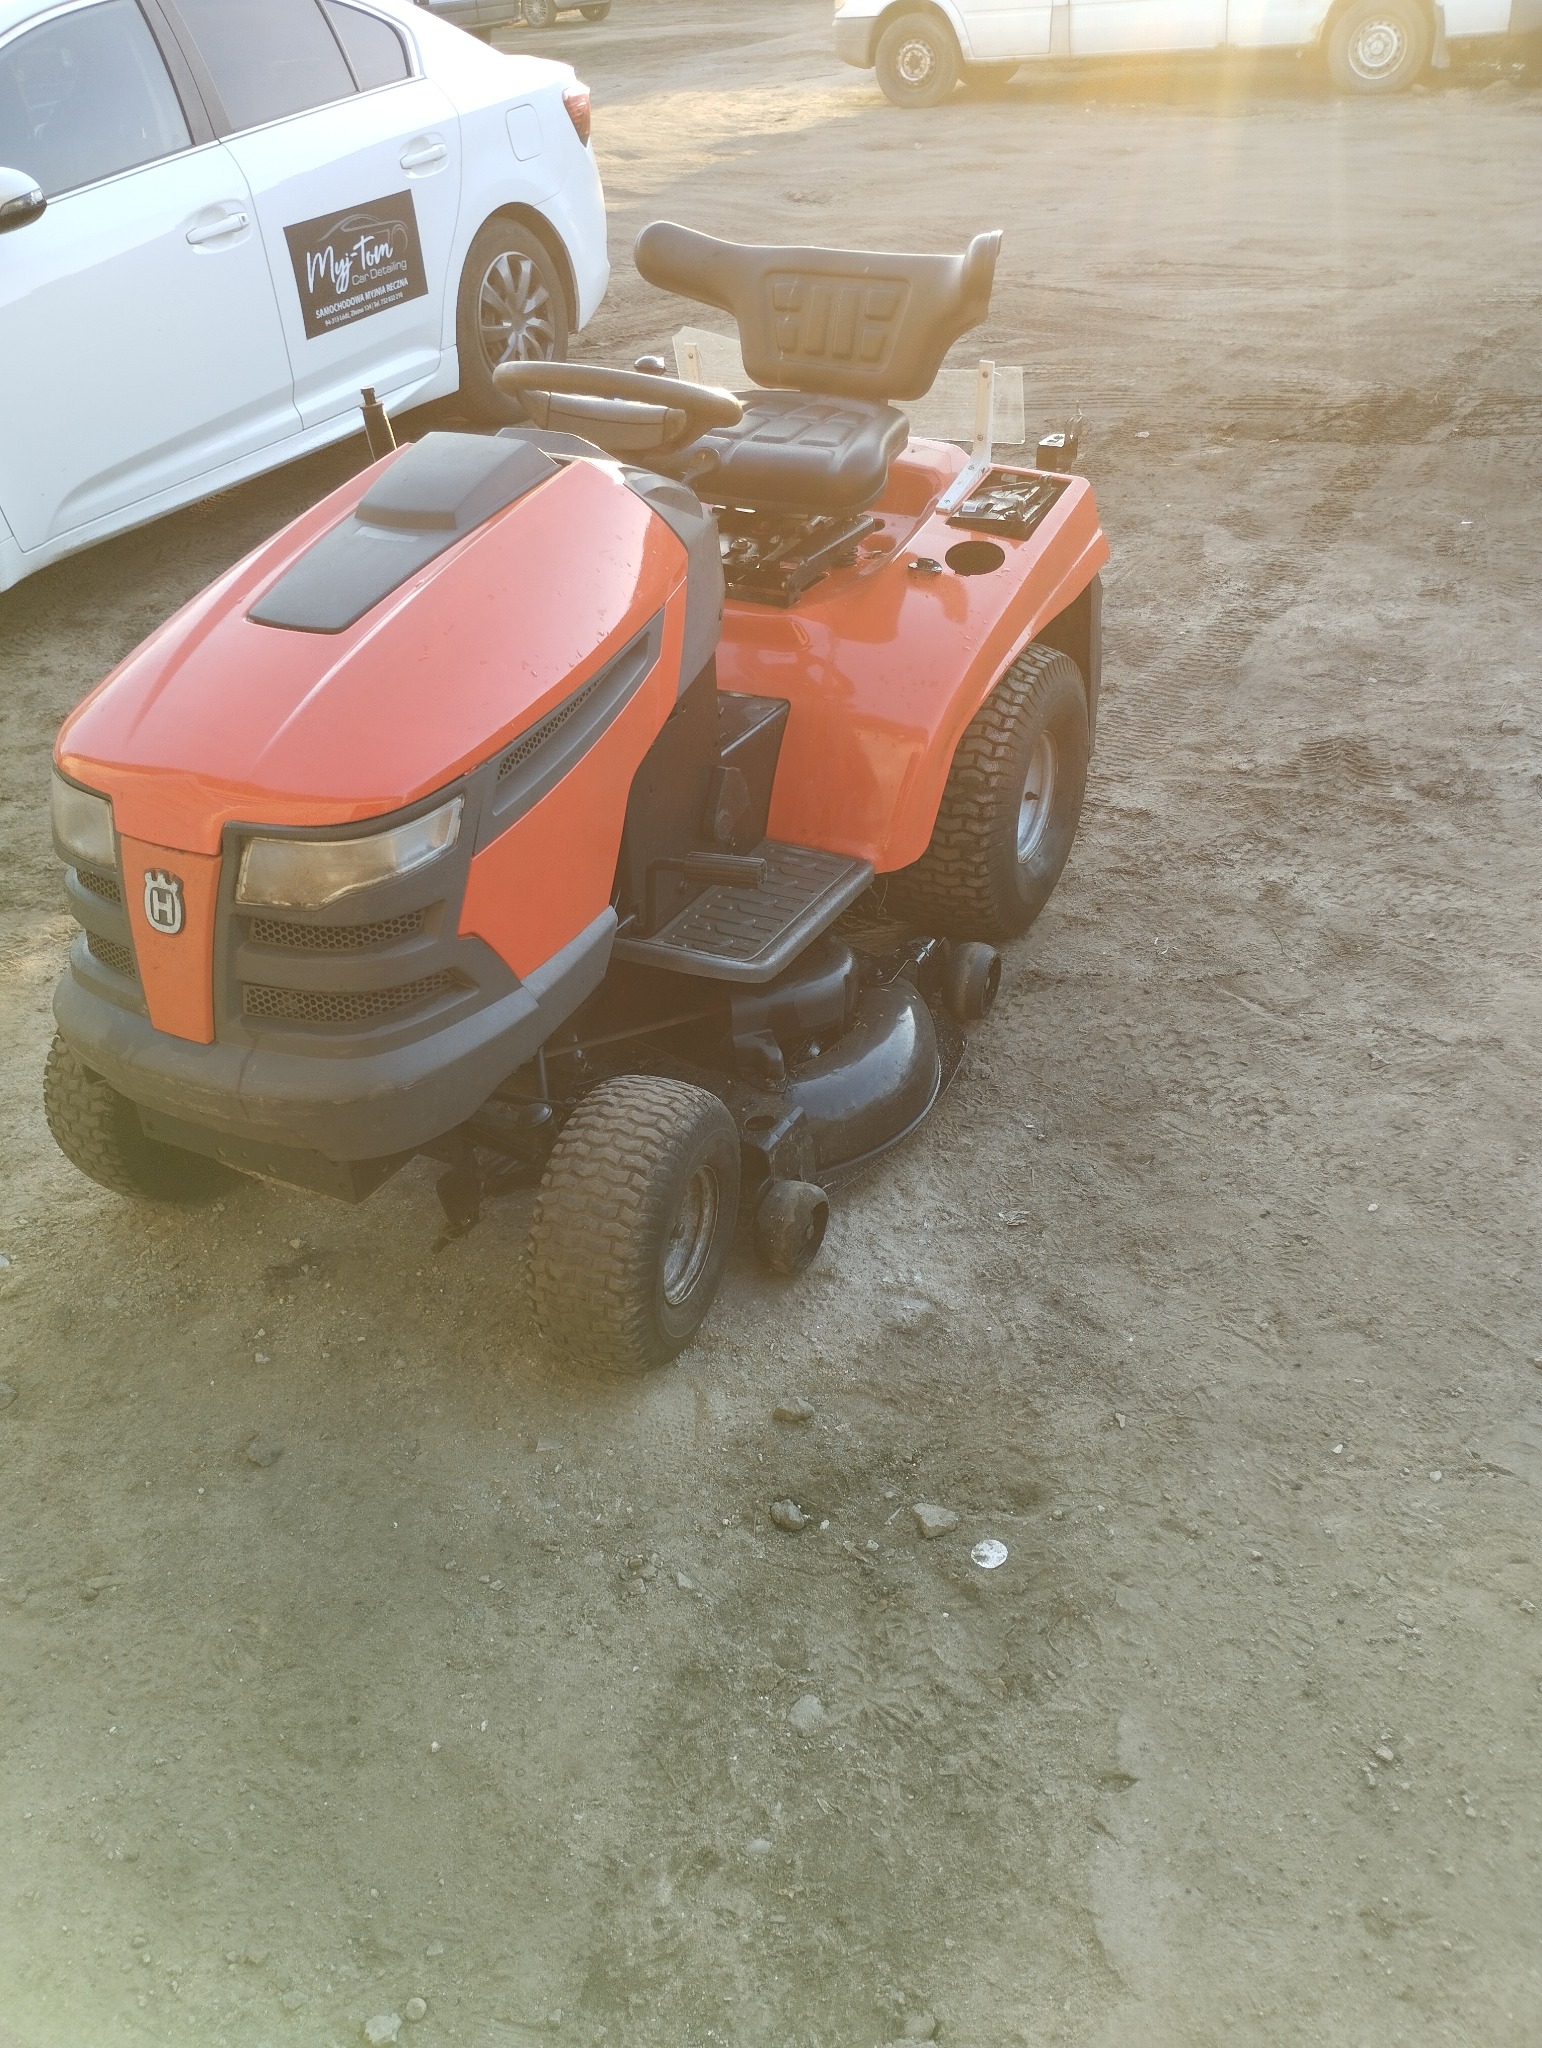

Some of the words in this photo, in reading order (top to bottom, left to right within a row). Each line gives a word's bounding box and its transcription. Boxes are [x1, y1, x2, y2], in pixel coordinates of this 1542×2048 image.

[306, 235, 394, 294] Myj-Tom
[351, 273, 370, 286] Car
[370, 260, 408, 279] Detailing
[315, 293, 365, 319] SAMOCHODOWA
